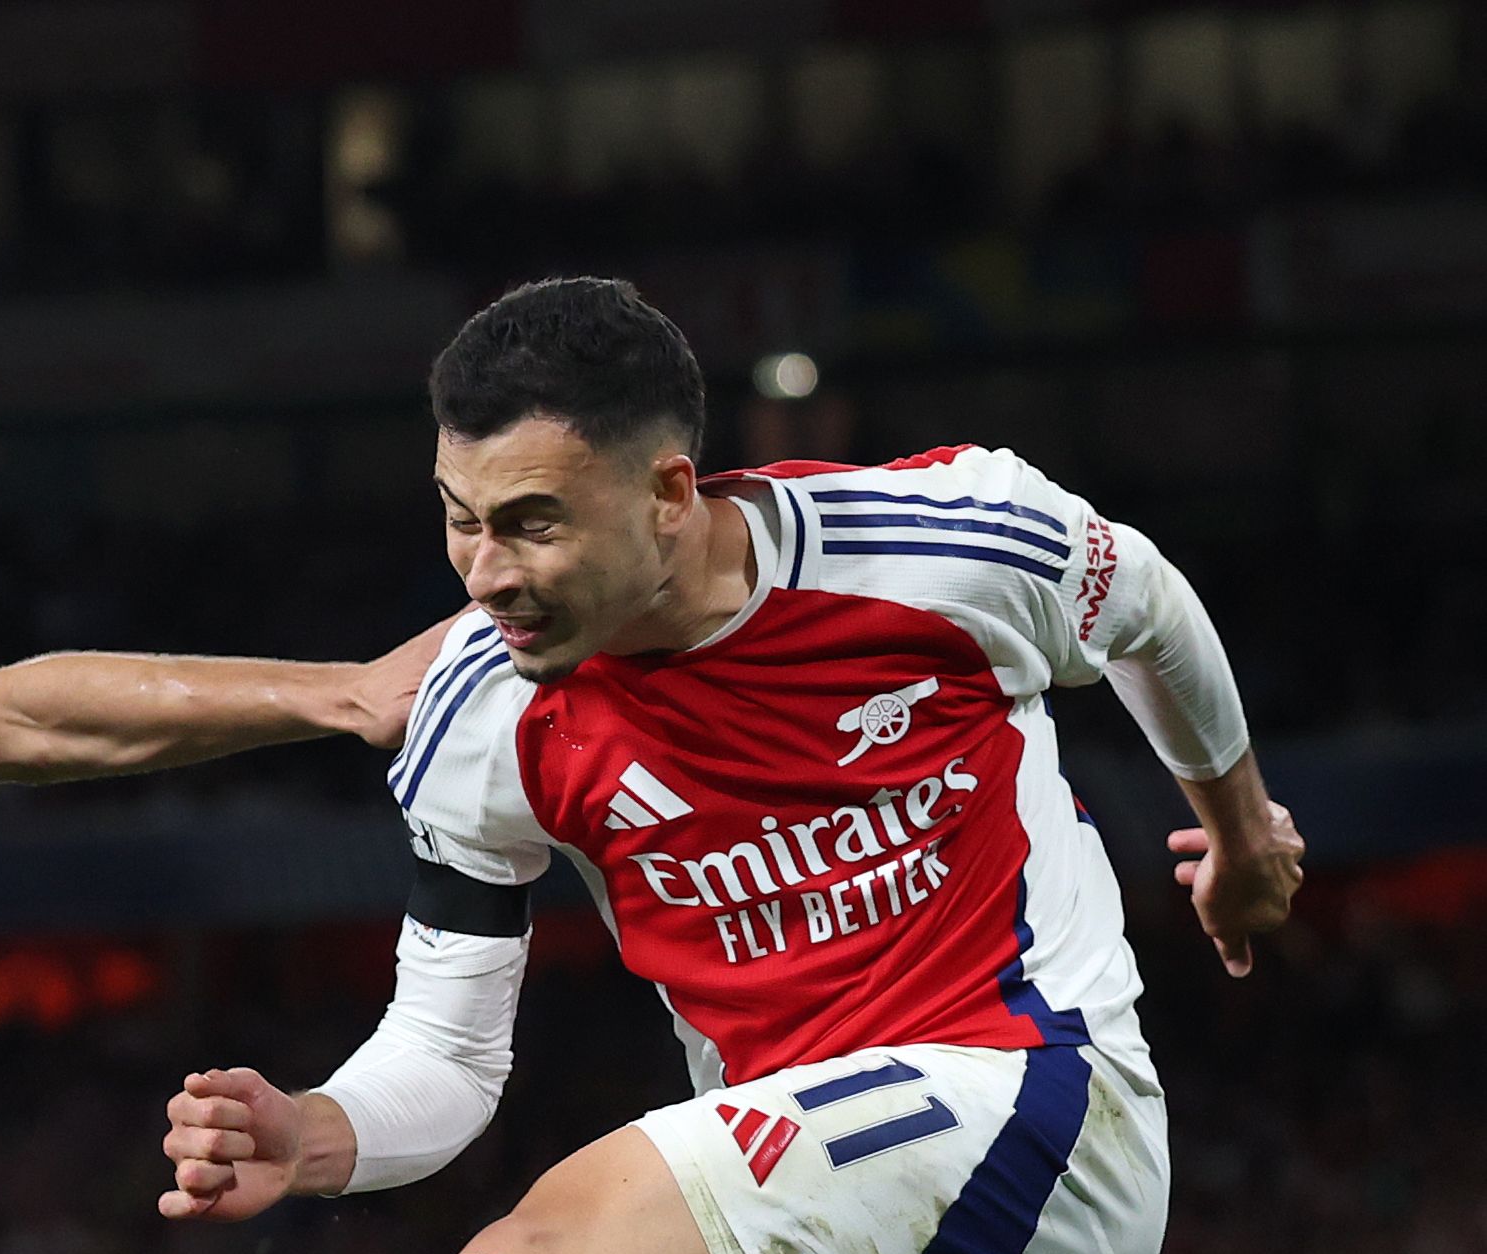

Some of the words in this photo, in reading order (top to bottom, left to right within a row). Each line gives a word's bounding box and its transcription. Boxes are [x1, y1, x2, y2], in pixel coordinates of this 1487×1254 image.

[627, 757, 978, 908] Emirates
[714, 899, 787, 963] FLY
[801, 836, 950, 944] BETTER
[788, 1054, 964, 1172] 11
